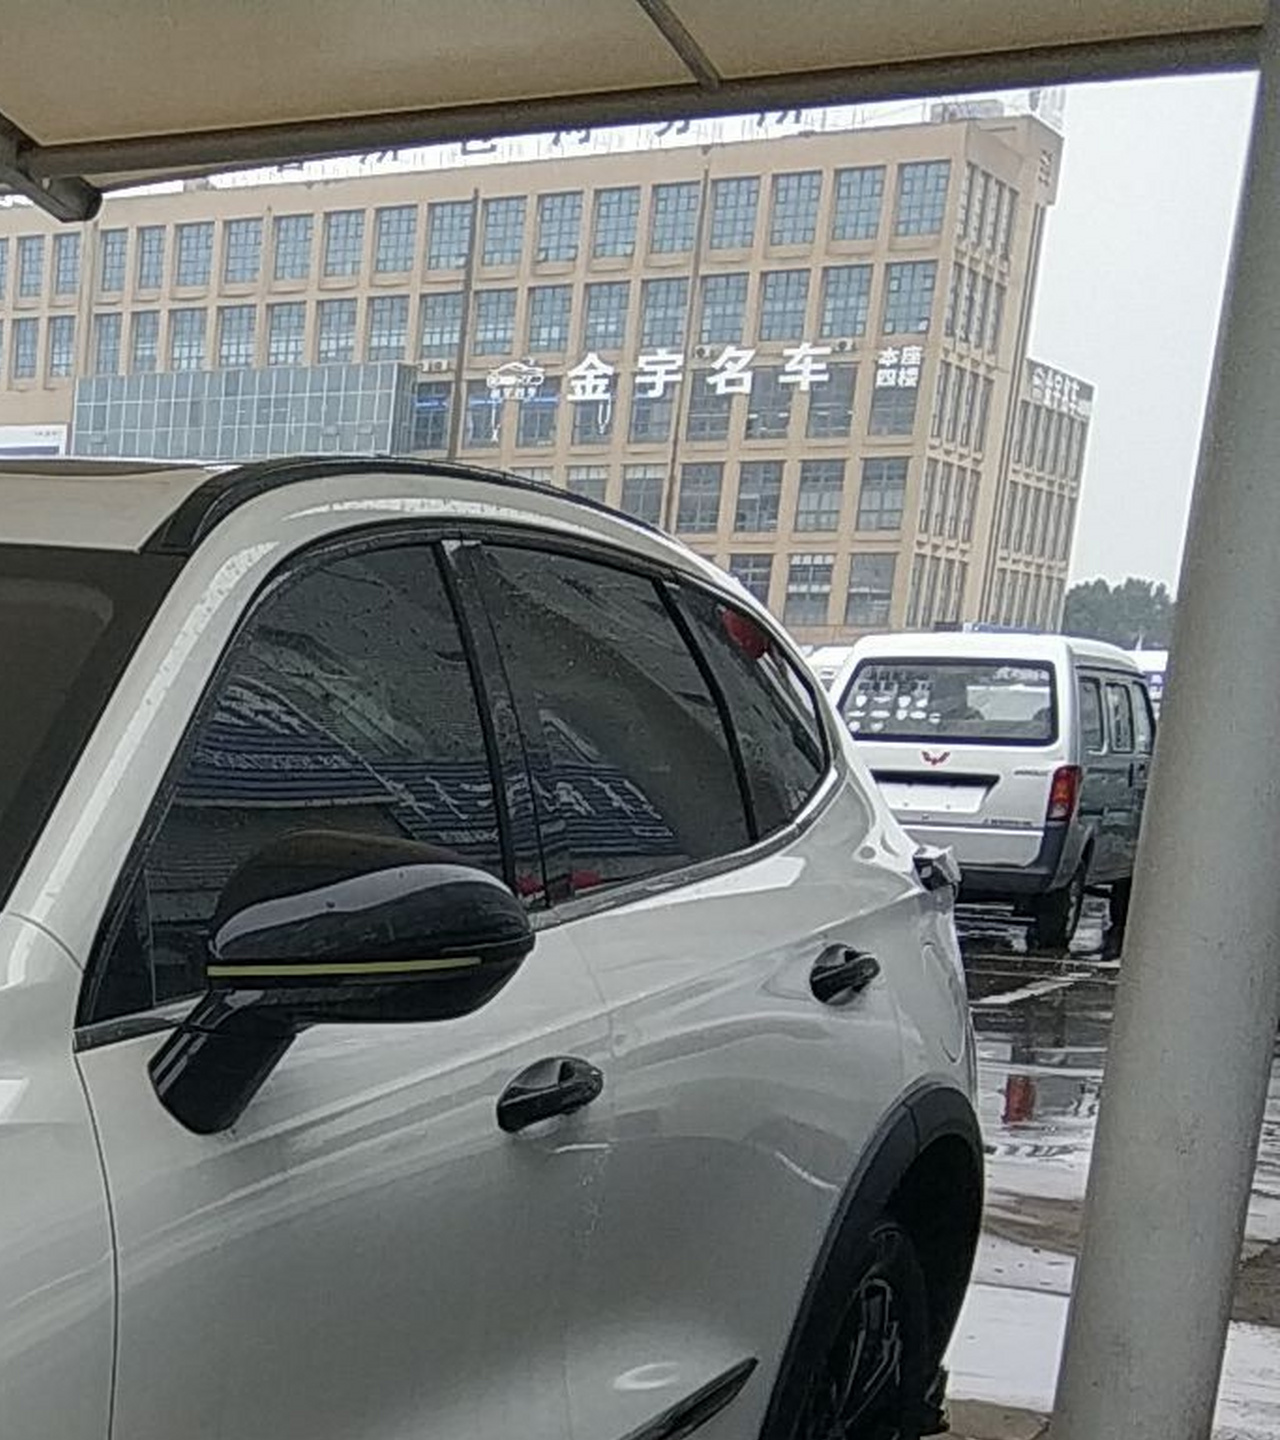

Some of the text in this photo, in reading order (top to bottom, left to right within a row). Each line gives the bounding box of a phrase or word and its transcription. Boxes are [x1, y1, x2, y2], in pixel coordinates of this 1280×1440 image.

[878, 345, 922, 367] 本座
[566, 342, 832, 400] 金宇名车
[876, 367, 921, 388] 四楼
